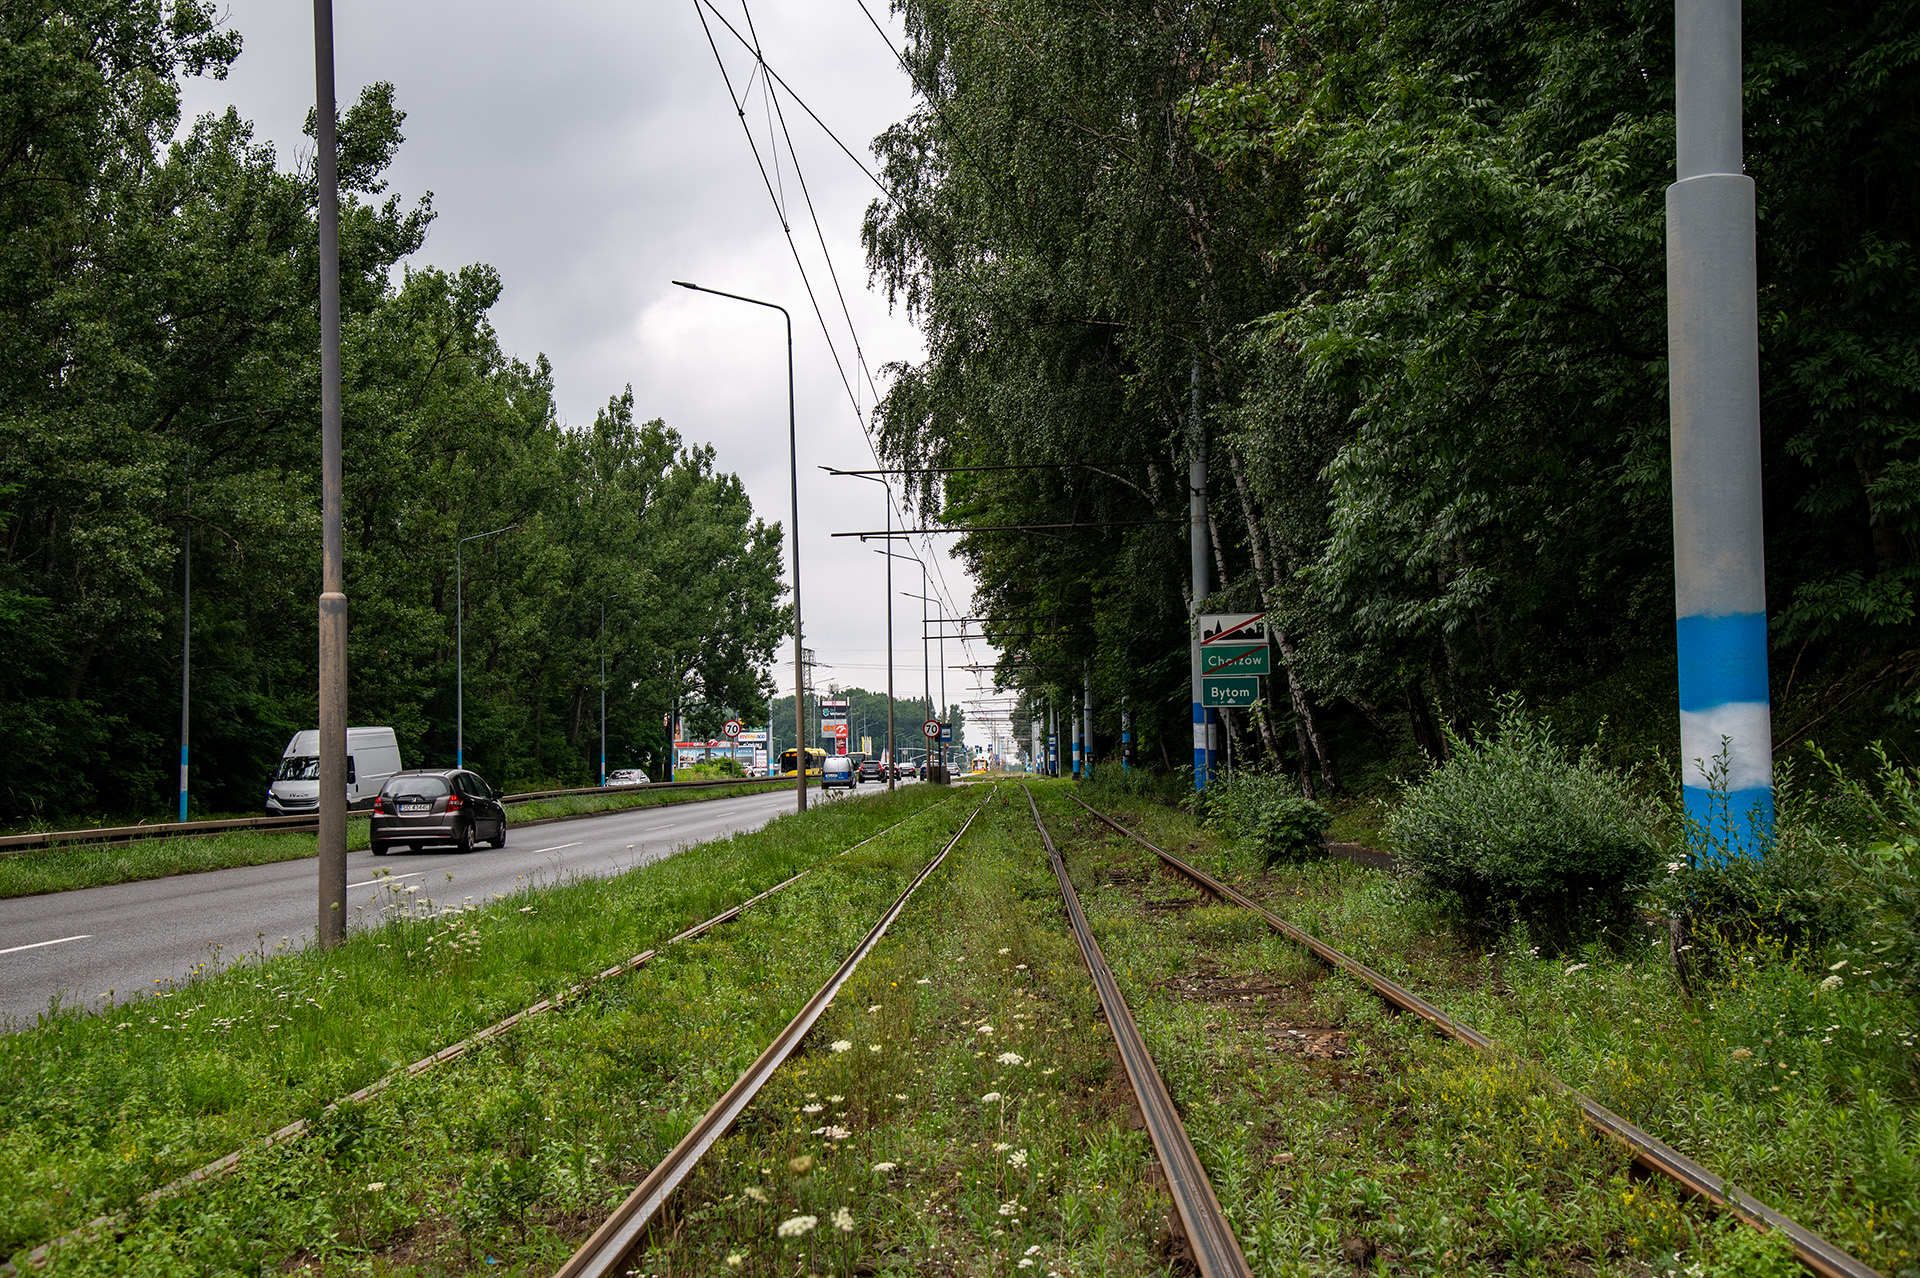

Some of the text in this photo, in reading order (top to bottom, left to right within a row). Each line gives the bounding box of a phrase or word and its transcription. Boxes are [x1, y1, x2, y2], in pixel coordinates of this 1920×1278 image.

[1208, 655, 1262, 666] Chorzów
[1211, 687, 1250, 700] Bytom
[726, 725, 738, 733] 70
[926, 725, 938, 733] 70
